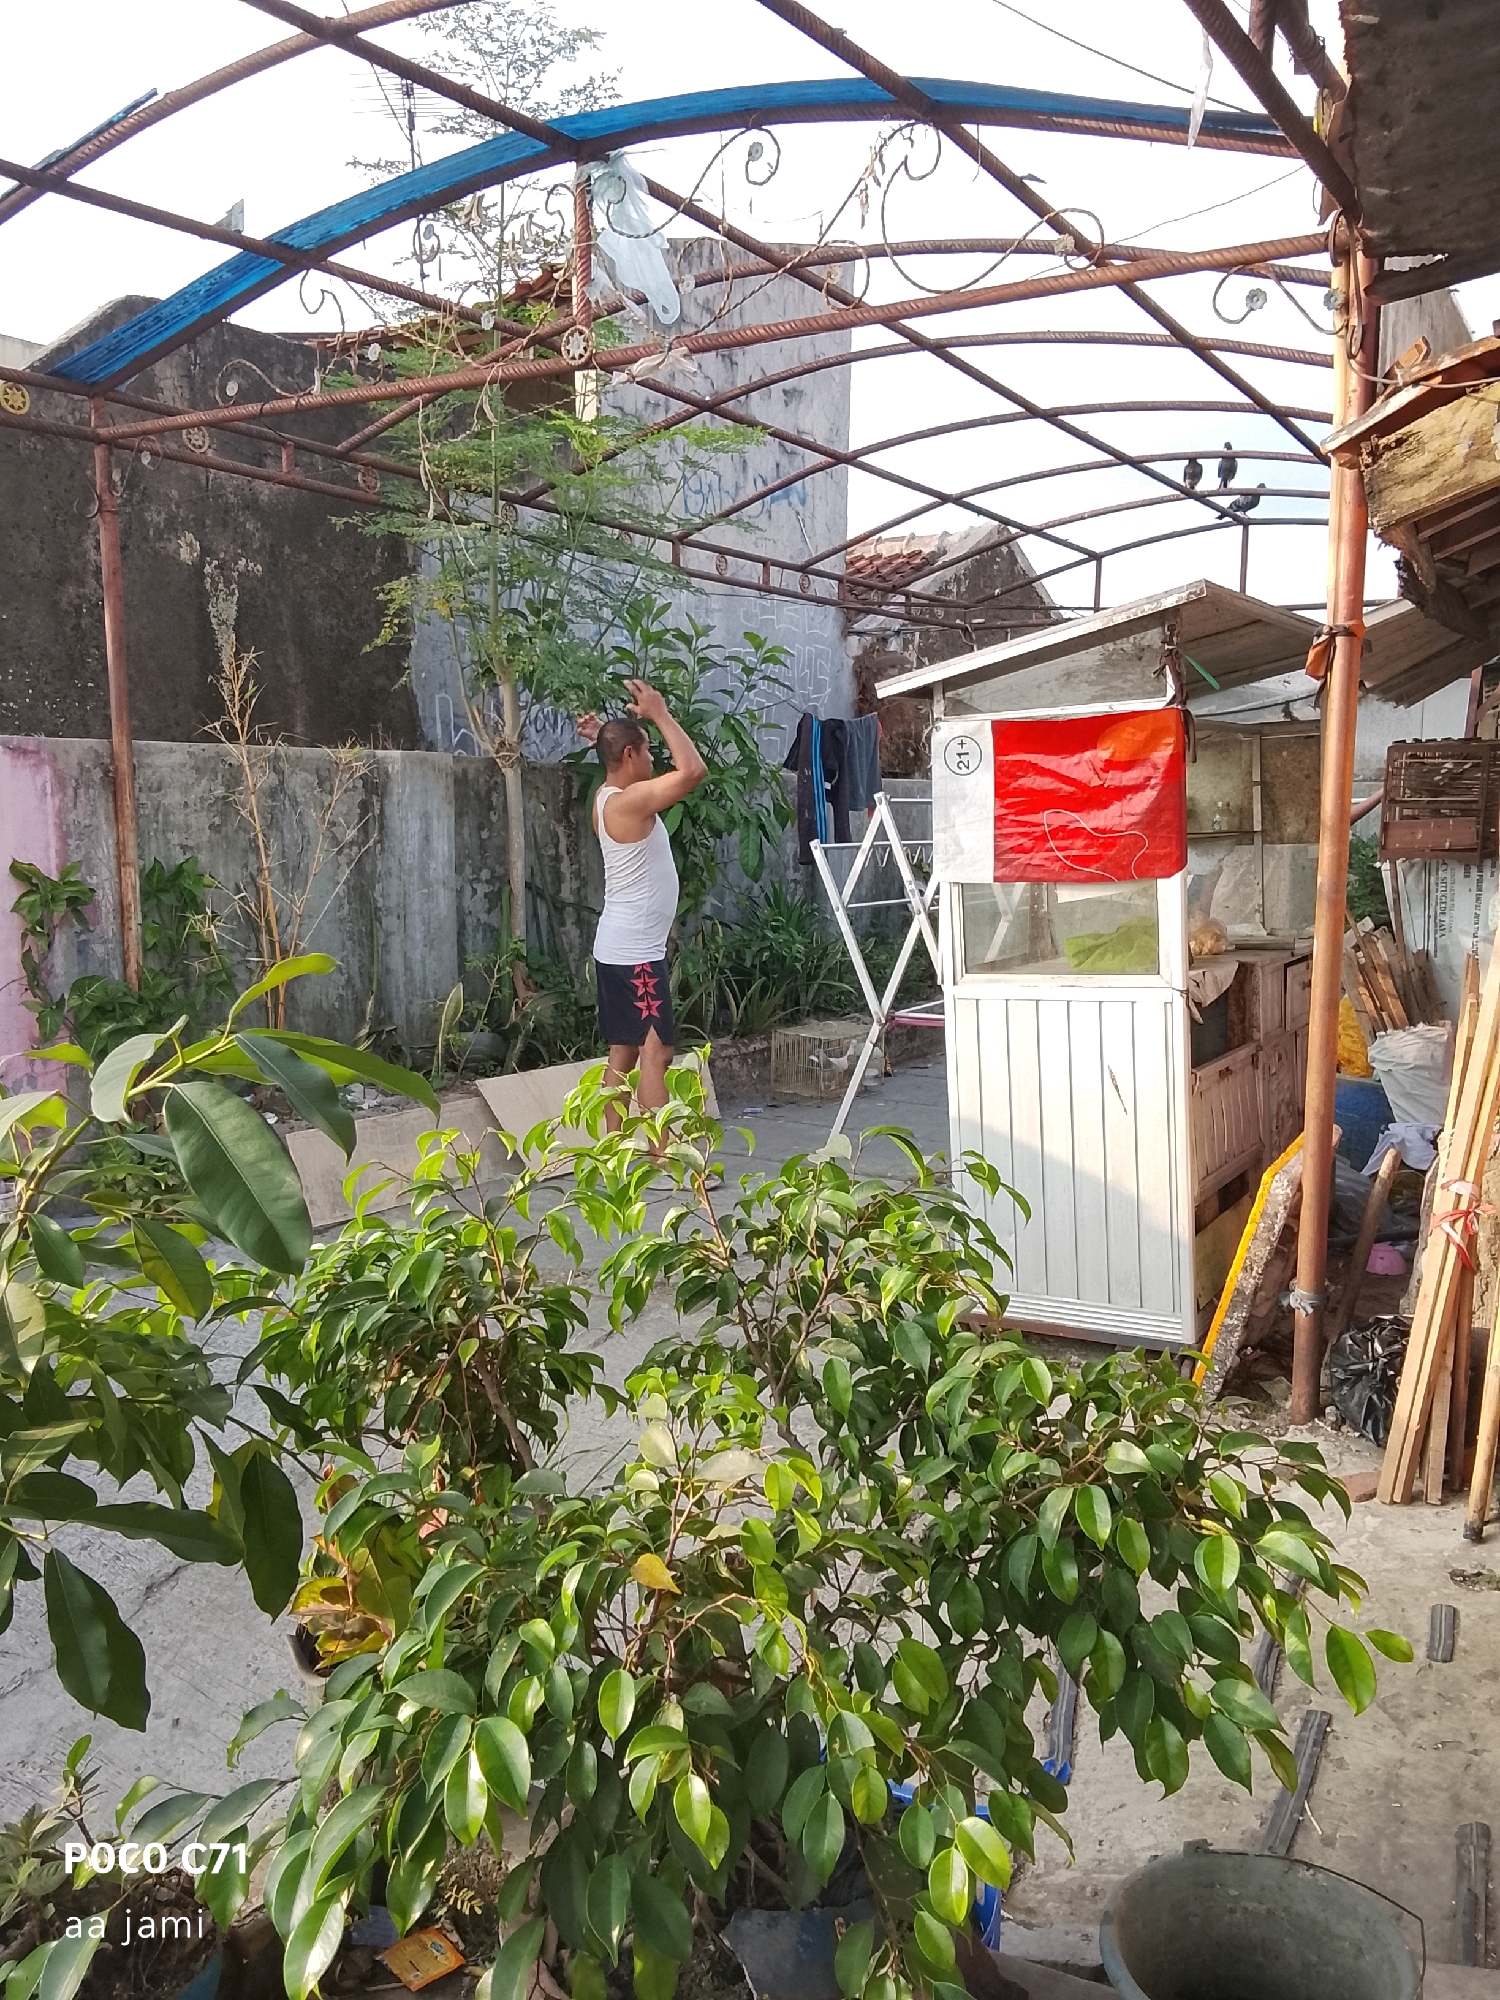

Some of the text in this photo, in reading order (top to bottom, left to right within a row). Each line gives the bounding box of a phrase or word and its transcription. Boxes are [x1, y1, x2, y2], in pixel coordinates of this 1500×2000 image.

[955, 738, 970, 771] 21+
[1438, 876, 1448, 917] SITUGEDE
[1438, 918, 1447, 939] JAYA
